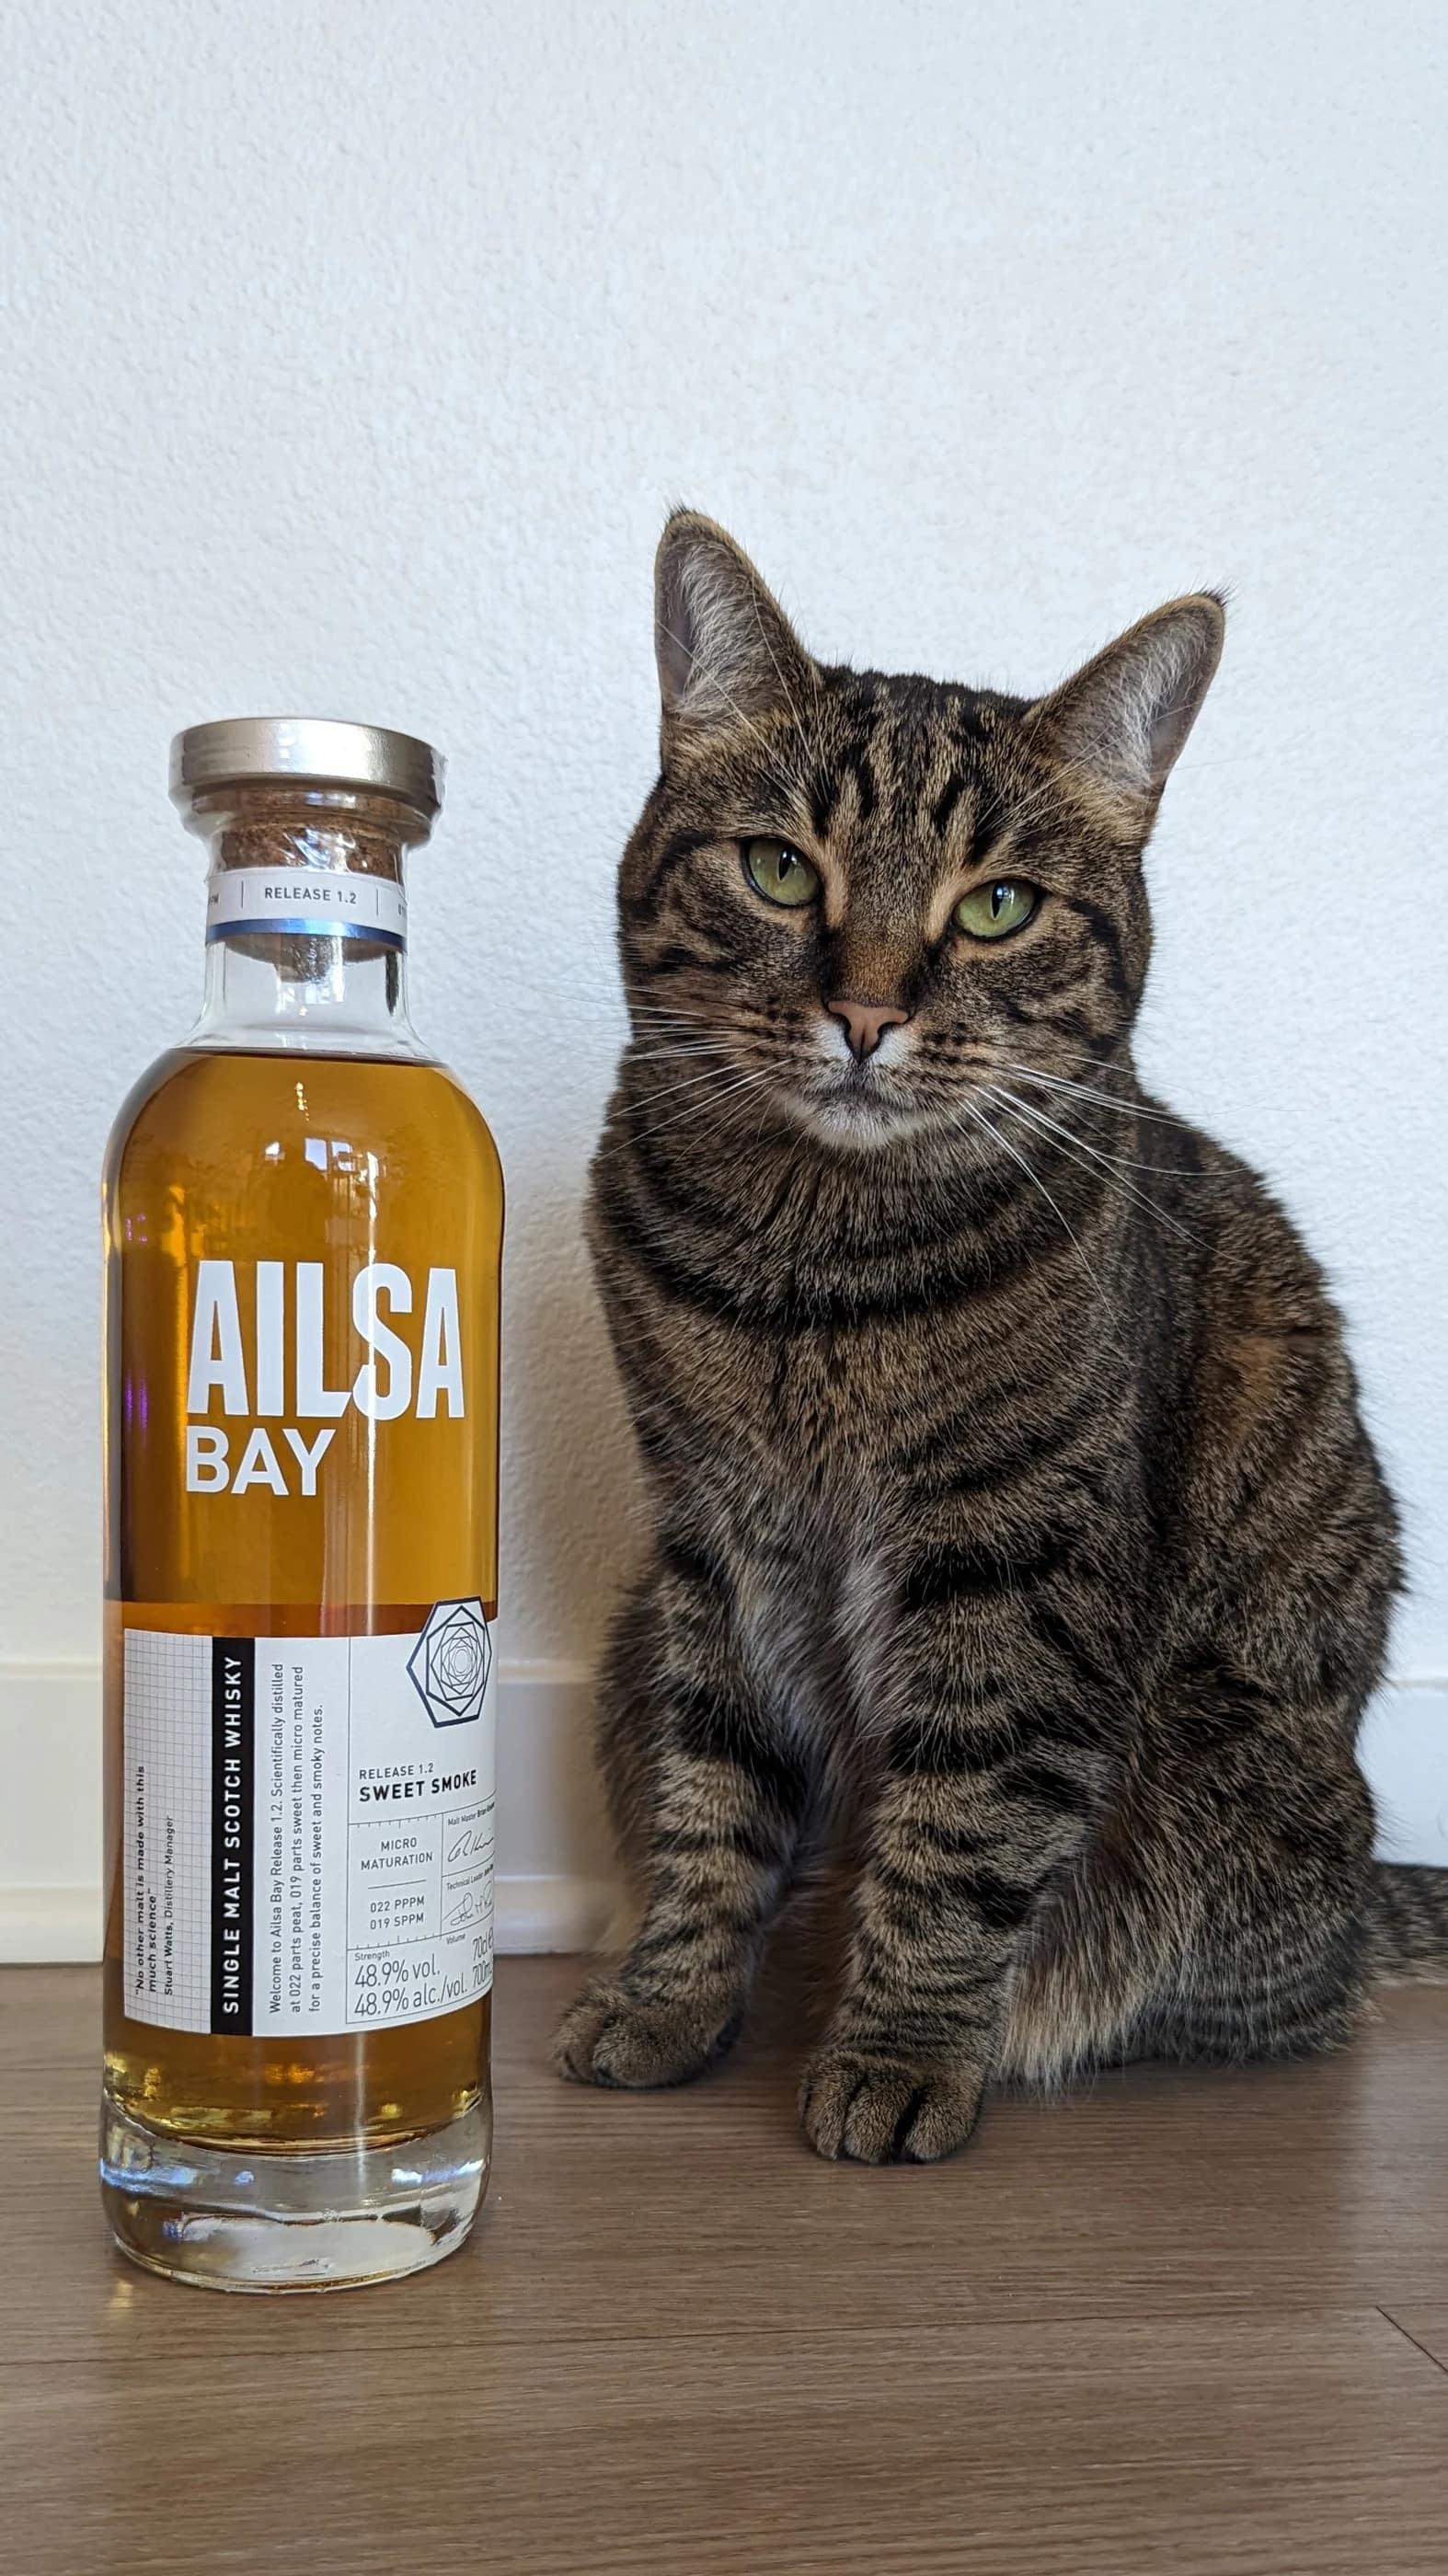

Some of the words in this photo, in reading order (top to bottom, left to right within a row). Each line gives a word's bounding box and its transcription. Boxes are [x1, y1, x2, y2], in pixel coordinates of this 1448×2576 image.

[265, 887, 331, 902] RELEASE
[338, 891, 357, 904] 1.2
[187, 1259, 465, 1420] AILSA
[186, 1425, 337, 1496] BAY
[224, 1657, 242, 1748] WHISKY
[271, 1664, 282, 1713] distilled
[292, 1667, 303, 1719] matured
[312, 1705, 322, 1743] notes.
[270, 1717, 285, 1797] Scientifically
[291, 1725, 303, 1760] micro
[136, 1766, 144, 1792] this
[291, 1765, 302, 1792] then
[311, 1748, 325, 1788] smoky
[359, 1765, 414, 1779] RELEASE
[419, 1763, 434, 1774] 1.2
[359, 1781, 425, 1801] SWEET
[431, 1769, 477, 1793] SMOKE
[136, 1798, 144, 1826] with
[224, 1759, 241, 1848] SCOTCH
[270, 1801, 282, 1822] 1.2.
[292, 1797, 303, 1834] sweet
[311, 1794, 322, 1816] and
[136, 1832, 144, 1869] made
[165, 1815, 175, 1864] Manager
[270, 1827, 282, 1876] Release
[292, 1839, 305, 1871] parts
[311, 1822, 322, 1858] sweet
[381, 1837, 418, 1851] MICRO
[310, 1863, 321, 1874] of
[361, 1851, 432, 1870] MATURATION
[136, 1875, 144, 1887] is
[165, 1869, 175, 1918] Distillery
[224, 1858, 240, 1917] MALT
[270, 1880, 284, 1903] Bay
[290, 1876, 302, 1898] 019
[136, 1891, 144, 1923] malt
[291, 1903, 304, 1933] peat,
[309, 1879, 321, 1927] balance
[370, 1901, 390, 1913] 022
[395, 1895, 425, 1910] PPPM
[270, 1907, 282, 1937] Ailsa
[370, 1918, 390, 1930] 019
[394, 1913, 424, 1926] SPPM
[135, 1927, 144, 1965] other
[165, 1922, 174, 1956] Watts,
[271, 1941, 281, 1952] to
[291, 1938, 304, 1970] parts
[309, 1933, 324, 1978] precise
[354, 1949, 390, 1961] Strength
[446, 1933, 466, 1945] Volume
[148, 1954, 157, 1992] much
[165, 1961, 173, 1995] Stuart
[224, 1928, 239, 2014] SINGLE
[270, 1957, 281, 2014] Welcome
[289, 1974, 301, 1996] 022
[355, 1959, 408, 1988] 48.9%
[412, 1953, 441, 1979] vol.
[290, 2001, 301, 2012] at
[309, 1995, 320, 2011] for
[354, 1987, 408, 2016] 48.9%
[413, 1972, 467, 2007] alc./vol.
